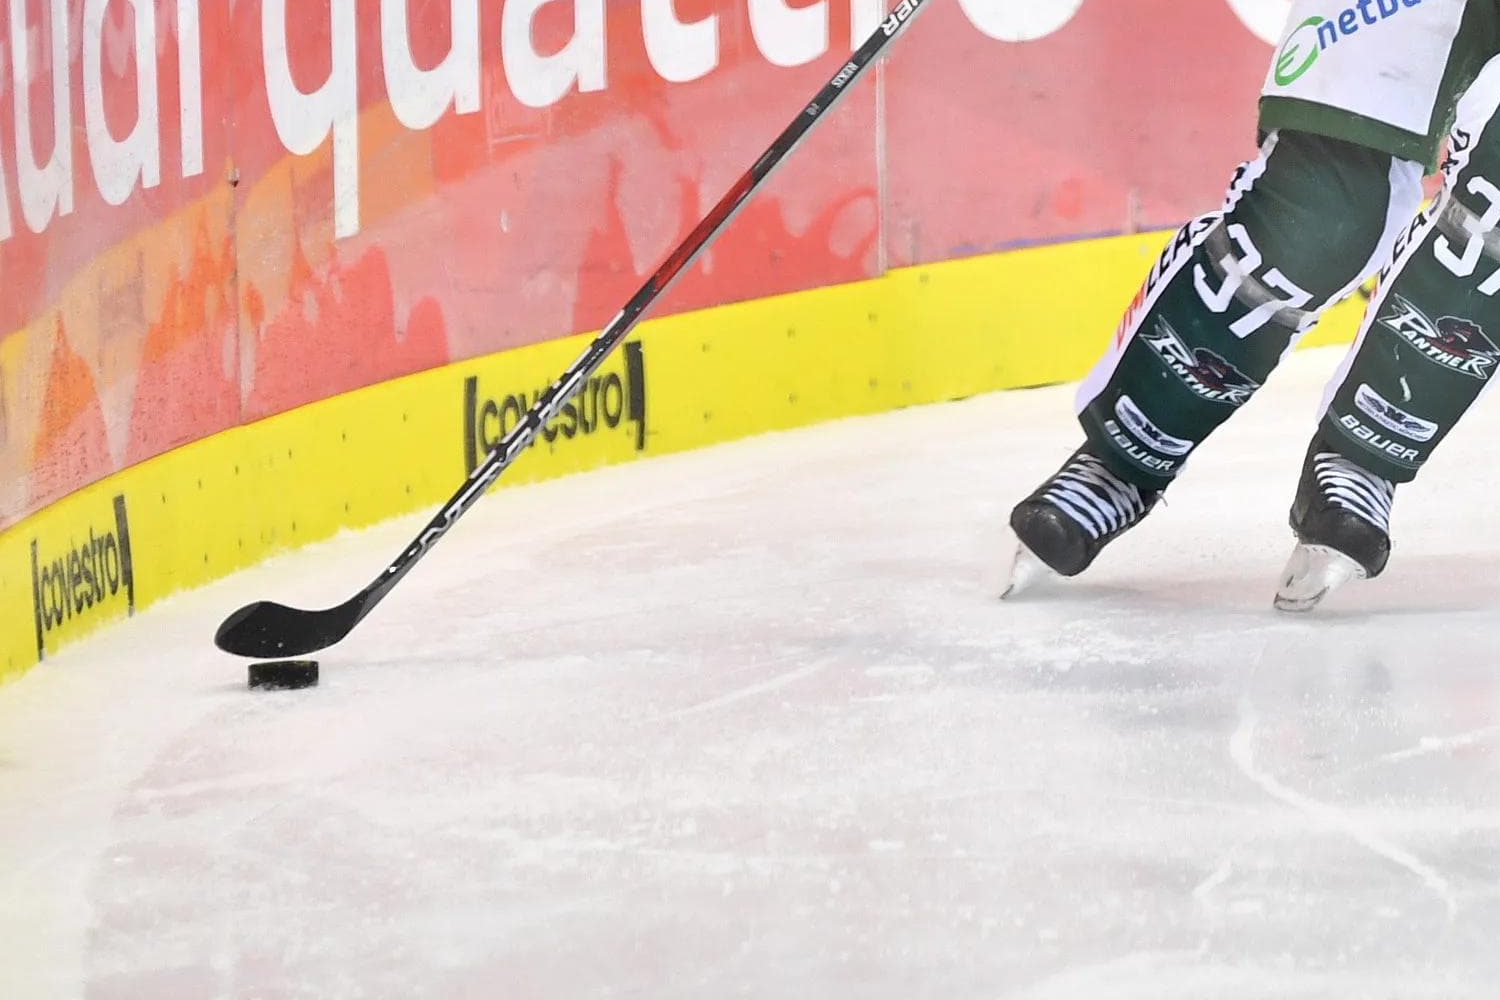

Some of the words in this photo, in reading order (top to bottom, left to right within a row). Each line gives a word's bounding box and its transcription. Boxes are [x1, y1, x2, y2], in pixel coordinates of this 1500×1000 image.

[1193, 223, 1315, 340] 37
[1378, 298, 1500, 380] PANTHER
[41, 530, 118, 632] covestro
